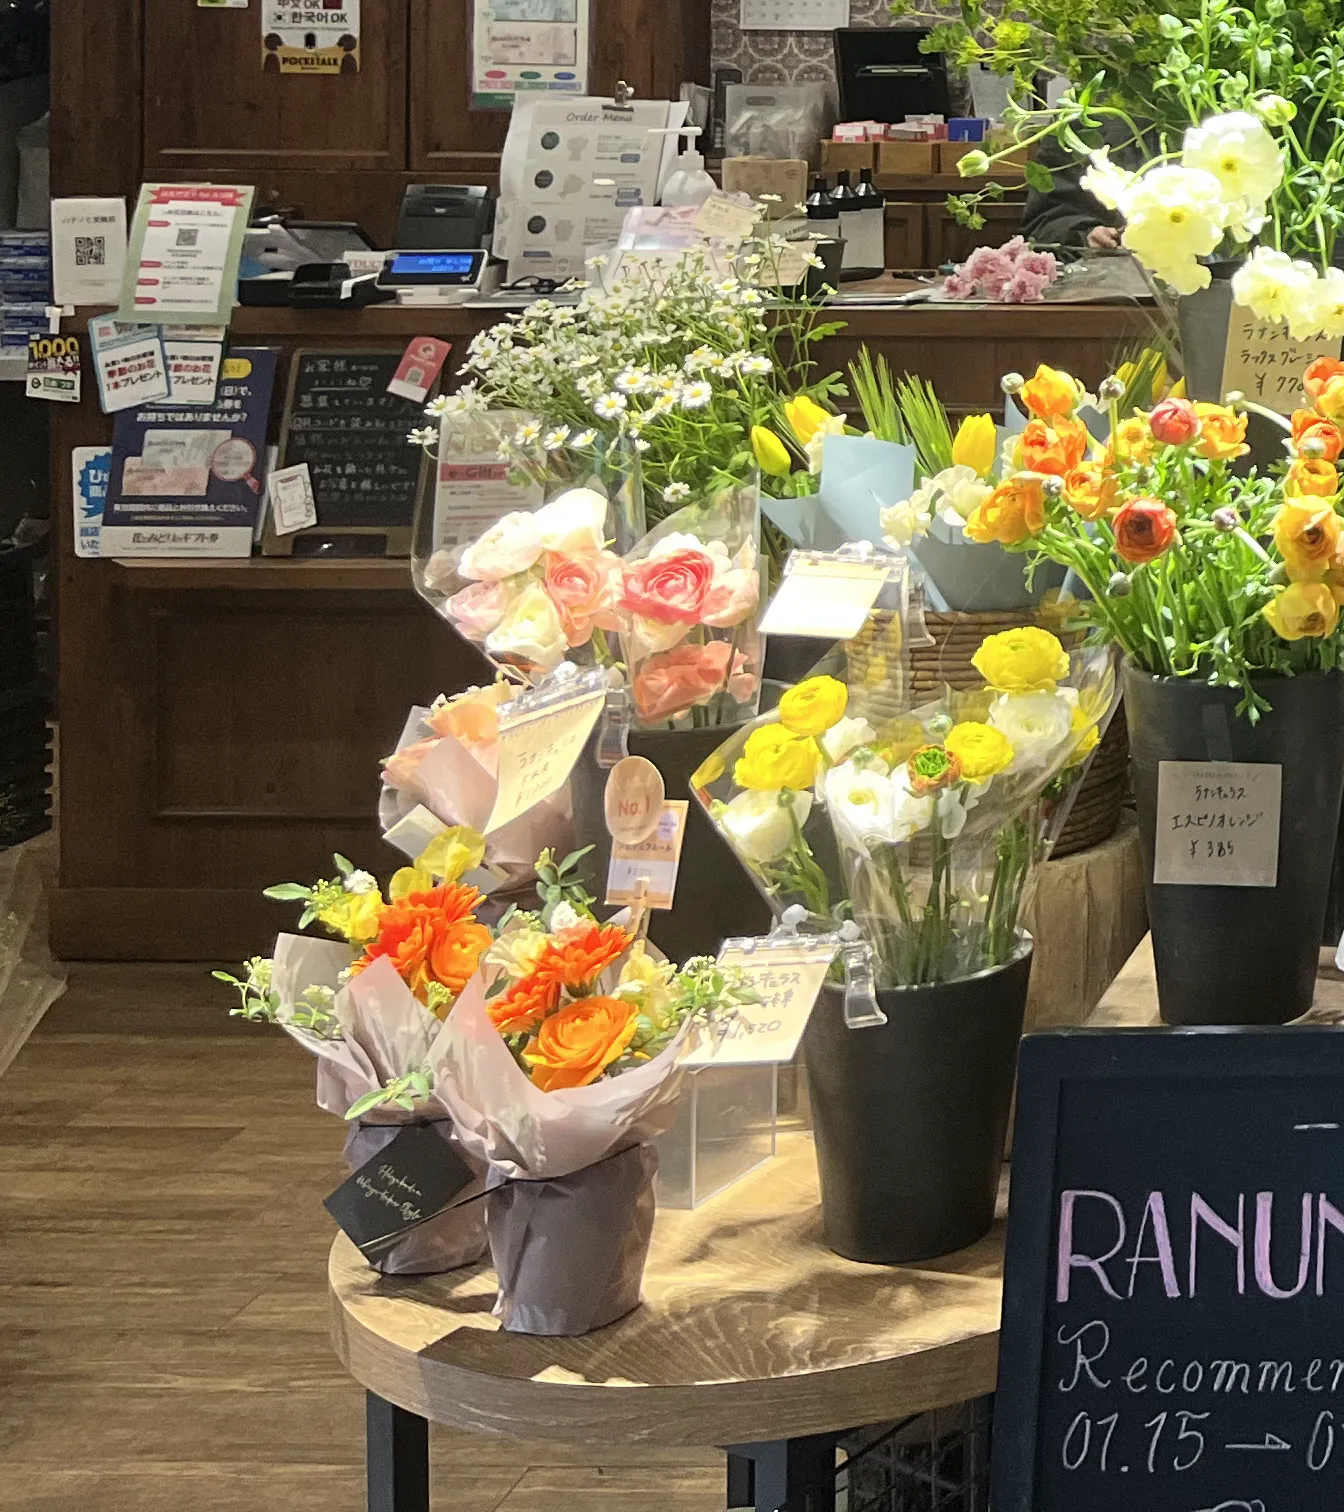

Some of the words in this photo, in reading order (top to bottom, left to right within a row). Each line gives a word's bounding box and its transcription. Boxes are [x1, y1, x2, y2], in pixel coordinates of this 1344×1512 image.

[291, 11, 328, 24] 한국어
[330, 12, 348, 24] OK
[566, 112, 600, 123] Order
[602, 113, 634, 123] Menu
[618, 796, 650, 816] No.1
[1062, 1408, 1209, 1475] 01.15
